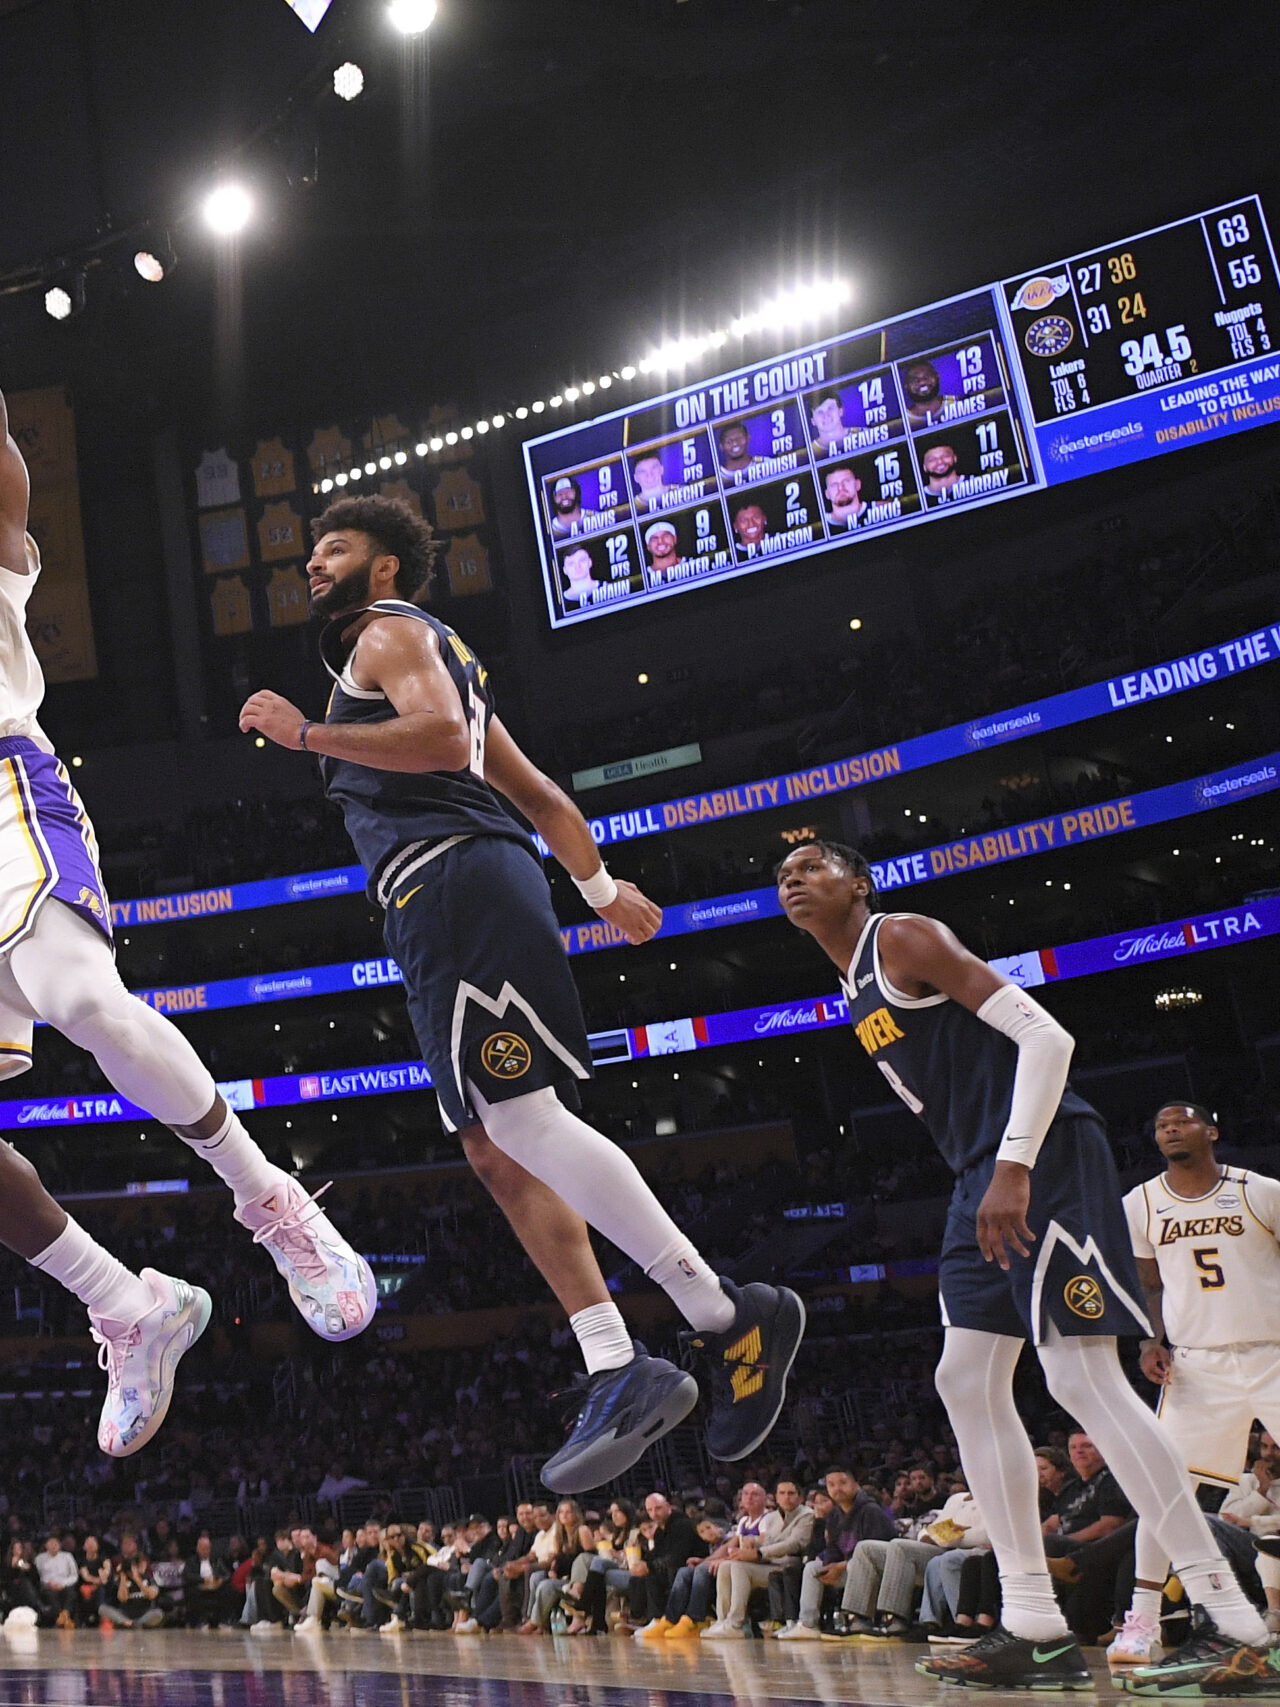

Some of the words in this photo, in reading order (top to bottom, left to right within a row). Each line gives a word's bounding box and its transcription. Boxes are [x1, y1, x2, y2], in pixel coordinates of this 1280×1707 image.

[1217, 214, 1250, 248] 63
[1077, 262, 1102, 295] 27
[1107, 253, 1136, 284] 36
[1227, 254, 1262, 289] 55
[1086, 303, 1111, 334] 31
[1118, 292, 1147, 324] 24
[1214, 302, 1263, 327] Nuggets
[1256, 318, 1266, 333] 4
[1120, 324, 1192, 377] 34.5
[1261, 334, 1271, 350] 3
[956, 346, 983, 377] 13
[1049, 358, 1085, 379] Lakers
[1135, 363, 1182, 390] QUARTER
[1189, 359, 1198, 373] 2
[675, 391, 707, 428] ON
[709, 377, 750, 416] THE
[754, 351, 827, 402] COURT
[858, 377, 884, 409] 14
[963, 374, 986, 394] PTS
[1081, 388, 1090, 404] 4
[1160, 384, 1219, 411] LEADING
[1219, 374, 1249, 393] THE
[1249, 364, 1280, 384] WAY
[865, 405, 887, 425] PTS
[940, 394, 986, 422] JAMES
[1197, 399, 1218, 415] TO
[1219, 389, 1255, 410] FULL
[771, 409, 785, 437] 3
[1156, 411, 1228, 444] DISABILITY
[682, 437, 696, 466] 5
[772, 435, 793, 455] PTS
[843, 424, 889, 452] REAVES
[975, 421, 999, 454] 11
[1058, 420, 1144, 456] easterseals
[684, 463, 703, 483] PTS
[748, 453, 797, 480] REDDISH
[874, 451, 901, 484] 15
[980, 449, 1004, 471] PTS
[598, 466, 612, 493] 9
[662, 481, 705, 506] KNECHT
[881, 479, 904, 500] PTS
[952, 468, 1010, 500] MURRAY
[599, 490, 618, 510] PTS
[785, 482, 801, 511] 2
[583, 509, 616, 534] DAVIS
[695, 509, 710, 538] 9
[786, 508, 807, 528] PTS
[605, 534, 629, 564] 12
[696, 534, 717, 555] PTS
[761, 526, 813, 555] WATSON
[611, 560, 630, 580] PTS
[667, 556, 710, 582] PORTER
[1107, 652, 1218, 708] LEADING
[1219, 631, 1270, 672] THE
[971, 710, 1041, 743] easterseals
[609, 809, 660, 840] FULL
[664, 783, 779, 828] DISABILITY
[787, 748, 902, 799] INCLUSION
[1202, 765, 1278, 799] easterseals
[871, 854, 927, 892] RATE
[930, 820, 1056, 876] DISABILITY
[1062, 801, 1137, 842] PRIDE
[291, 874, 350, 896] easterseals
[136, 888, 233, 922] INCLUSION
[691, 898, 759, 924] easterseals
[577, 922, 626, 948] PRID
[154, 985, 207, 1012] PRIDE
[253, 974, 313, 998] easterseals
[1158, 1215, 1246, 1246] LAKERS
[1193, 1247, 1226, 1292] 5
